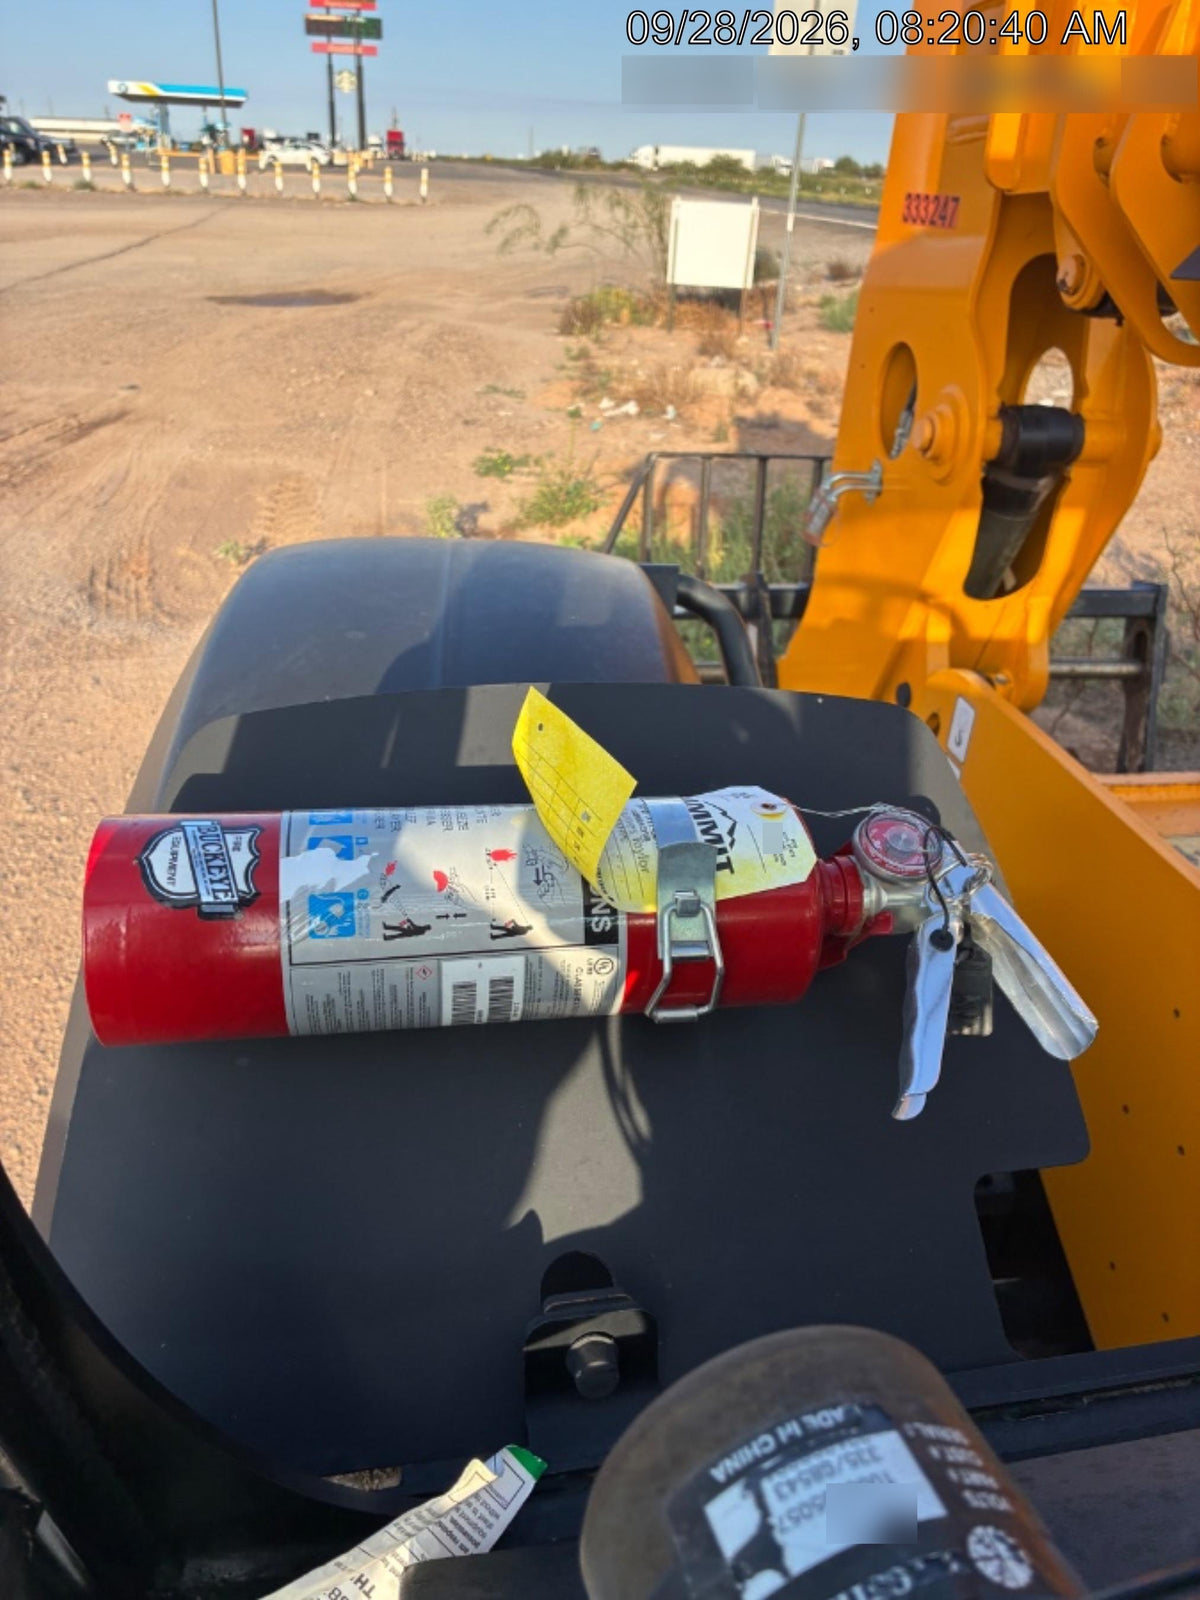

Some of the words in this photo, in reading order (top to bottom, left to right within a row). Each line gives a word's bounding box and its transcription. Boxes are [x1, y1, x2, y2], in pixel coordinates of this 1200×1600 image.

[902, 192, 960, 228] 333247
[166, 836, 182, 887] EQUIPMENT
[197, 825, 235, 901] BUCKEYE
[709, 1433, 777, 1484] CHINA
